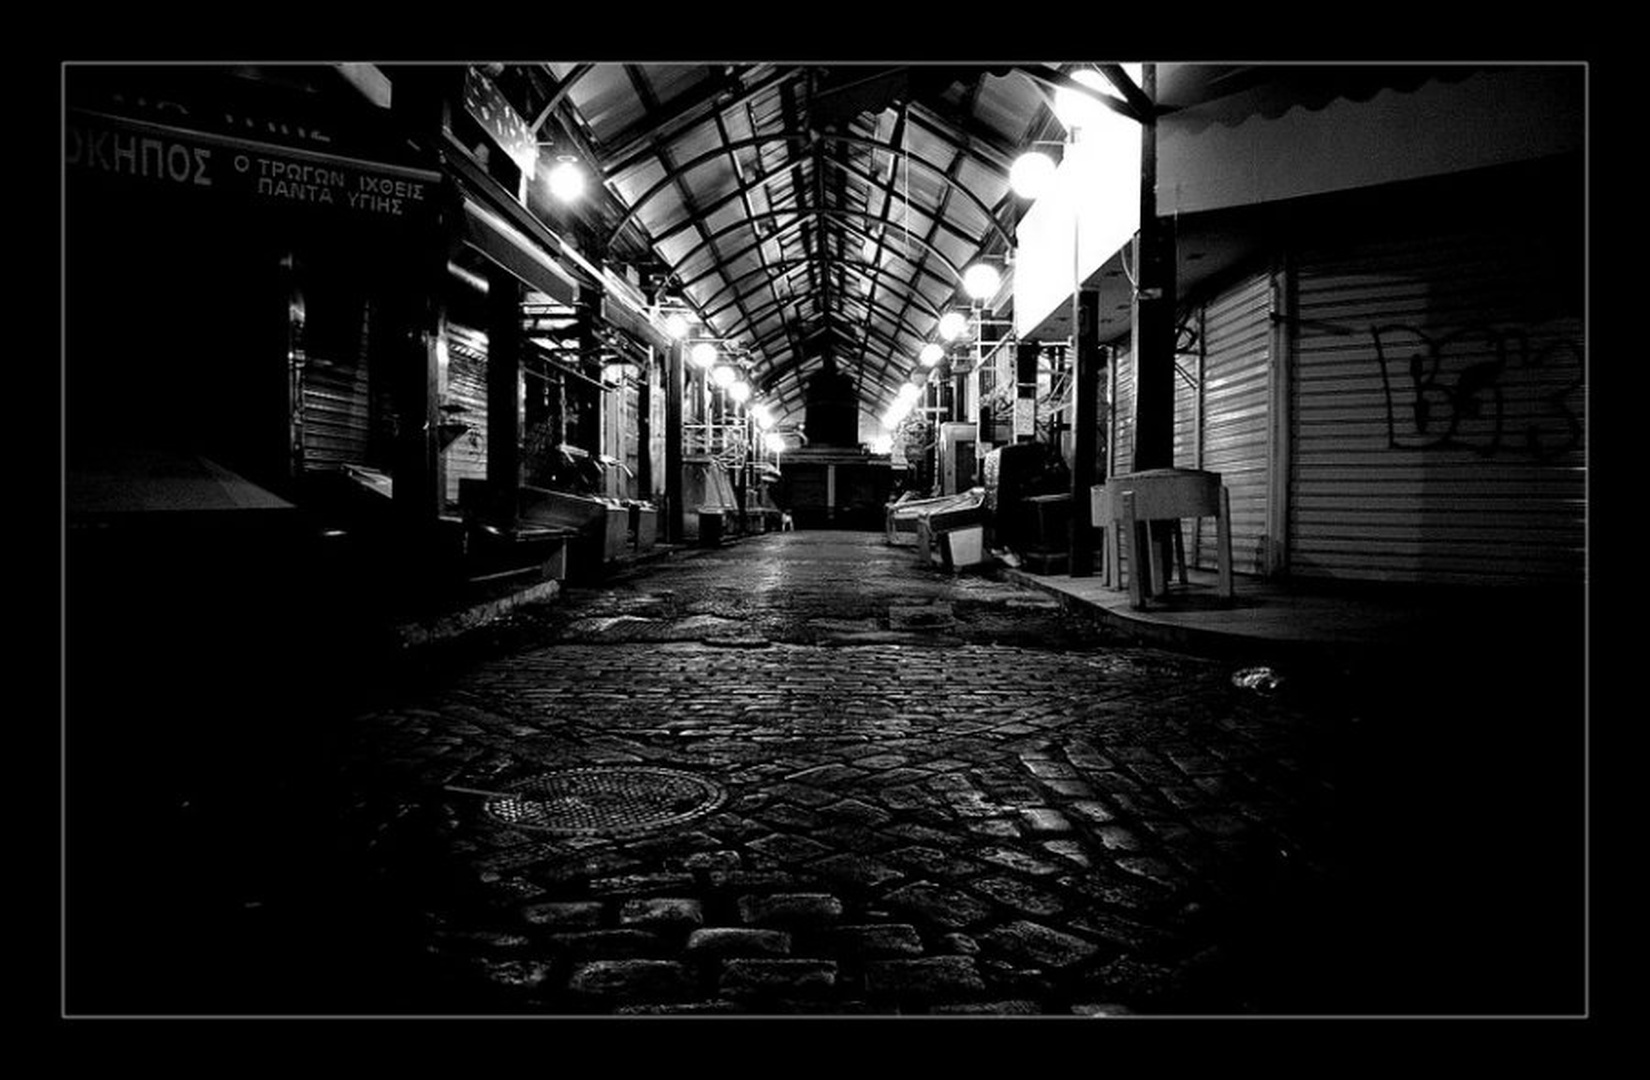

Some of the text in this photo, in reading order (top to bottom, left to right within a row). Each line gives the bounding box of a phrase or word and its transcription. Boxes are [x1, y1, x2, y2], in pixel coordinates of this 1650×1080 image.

[234, 154, 425, 201] Ο ΤΡΩΓΩΝ ΙΧΘΕΙΣ
[257, 177, 403, 216] ΠΑΝΤΑ ΥΓΙΗΣ
